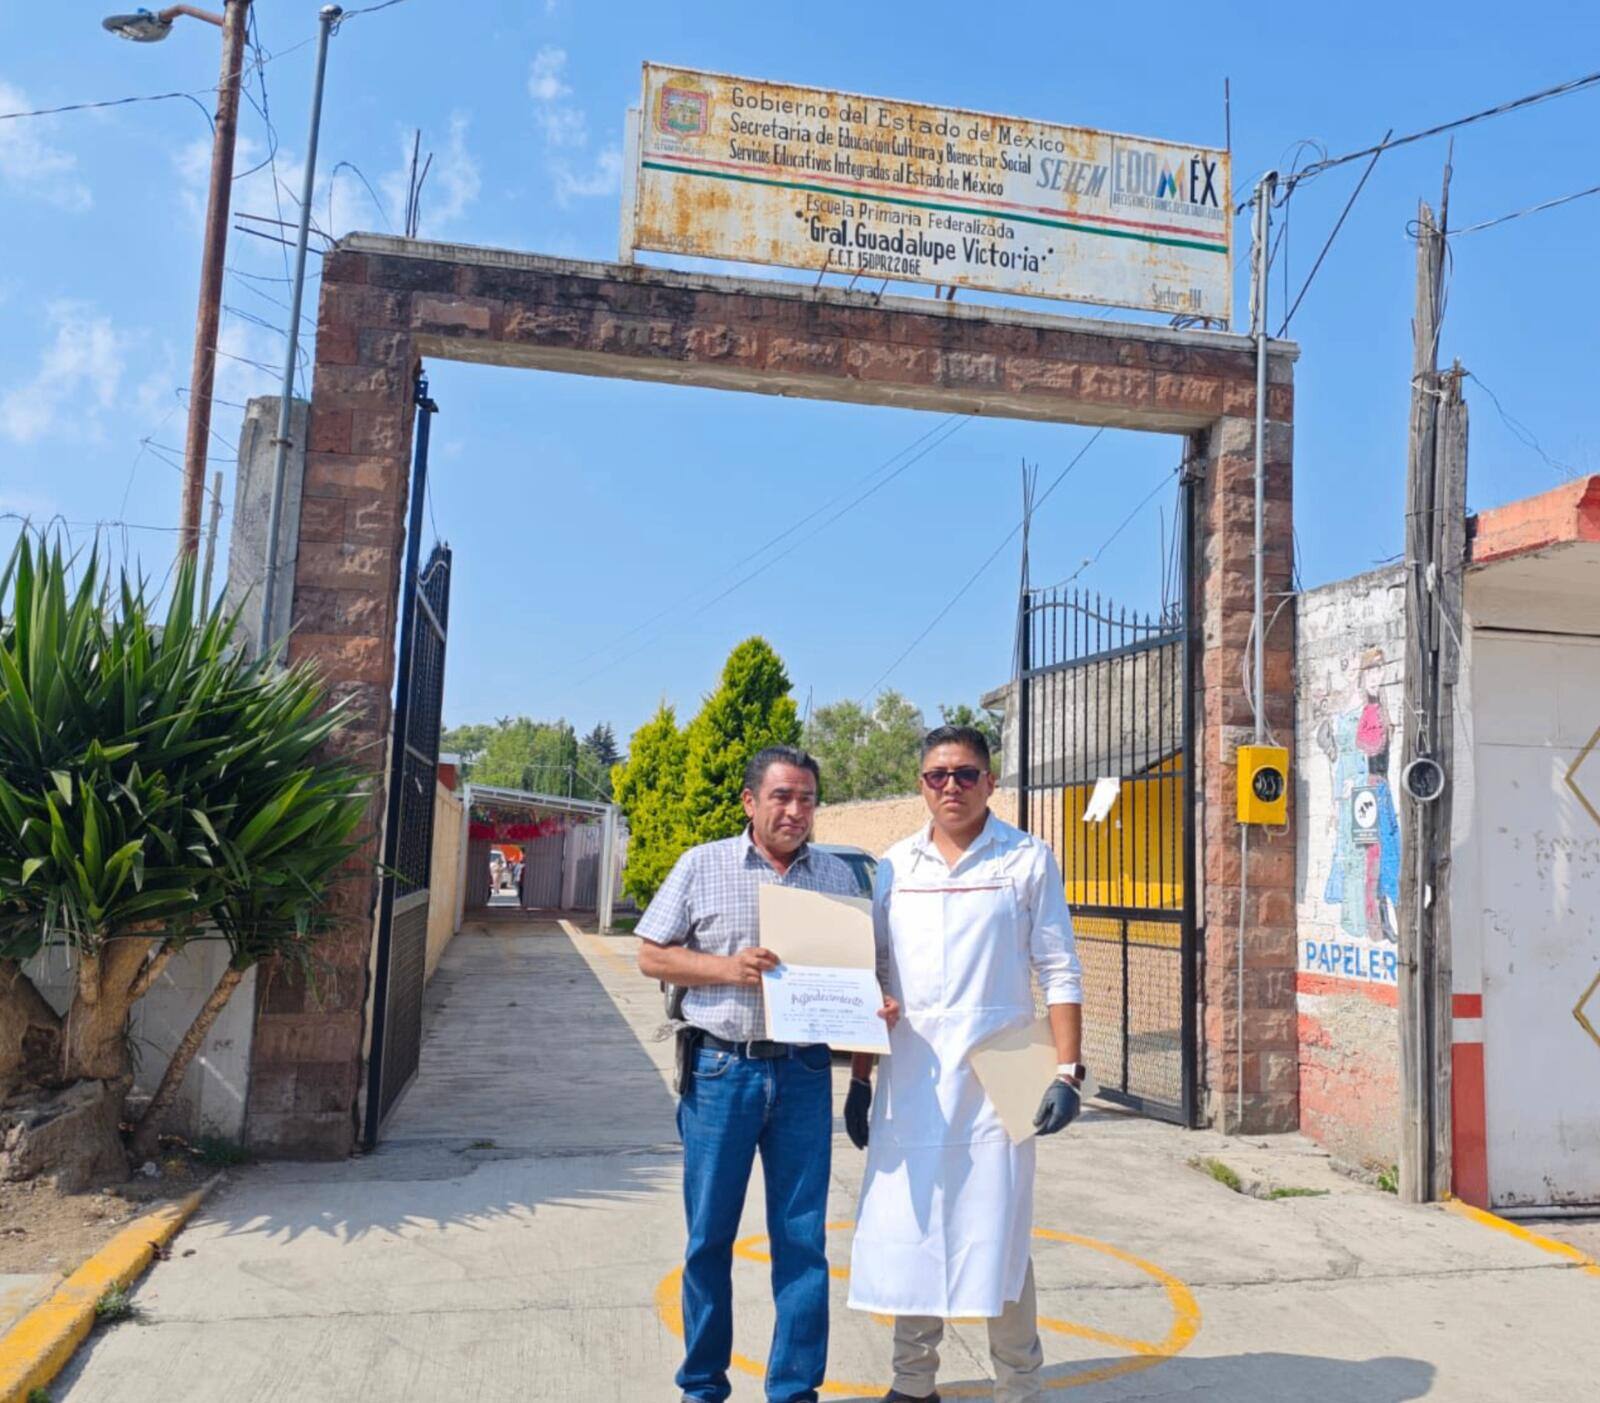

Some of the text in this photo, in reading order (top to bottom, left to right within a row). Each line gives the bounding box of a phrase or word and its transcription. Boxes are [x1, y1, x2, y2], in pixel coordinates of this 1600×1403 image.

[732, 87, 829, 118] Gobierno
[839, 103, 868, 125] del
[879, 107, 961, 138] Estado
[968, 122, 991, 141] de
[729, 139, 770, 164] Servicios
[773, 144, 832, 172] Educativos
[834, 153, 889, 180] Integrados
[892, 163, 903, 183] al
[906, 164, 944, 188] Estado
[946, 169, 960, 189] de
[962, 171, 1004, 196] México
[816, 125, 834, 145] de
[892, 136, 935, 161] Cultura
[936, 147, 944, 165] y
[946, 143, 998, 169] Bienestar
[1000, 151, 1032, 174] Social
[1036, 156, 1108, 198] SEIEM
[806, 193, 1015, 240] Escuela Primaria Federalizada
[855, 222, 956, 265] Guadalupe
